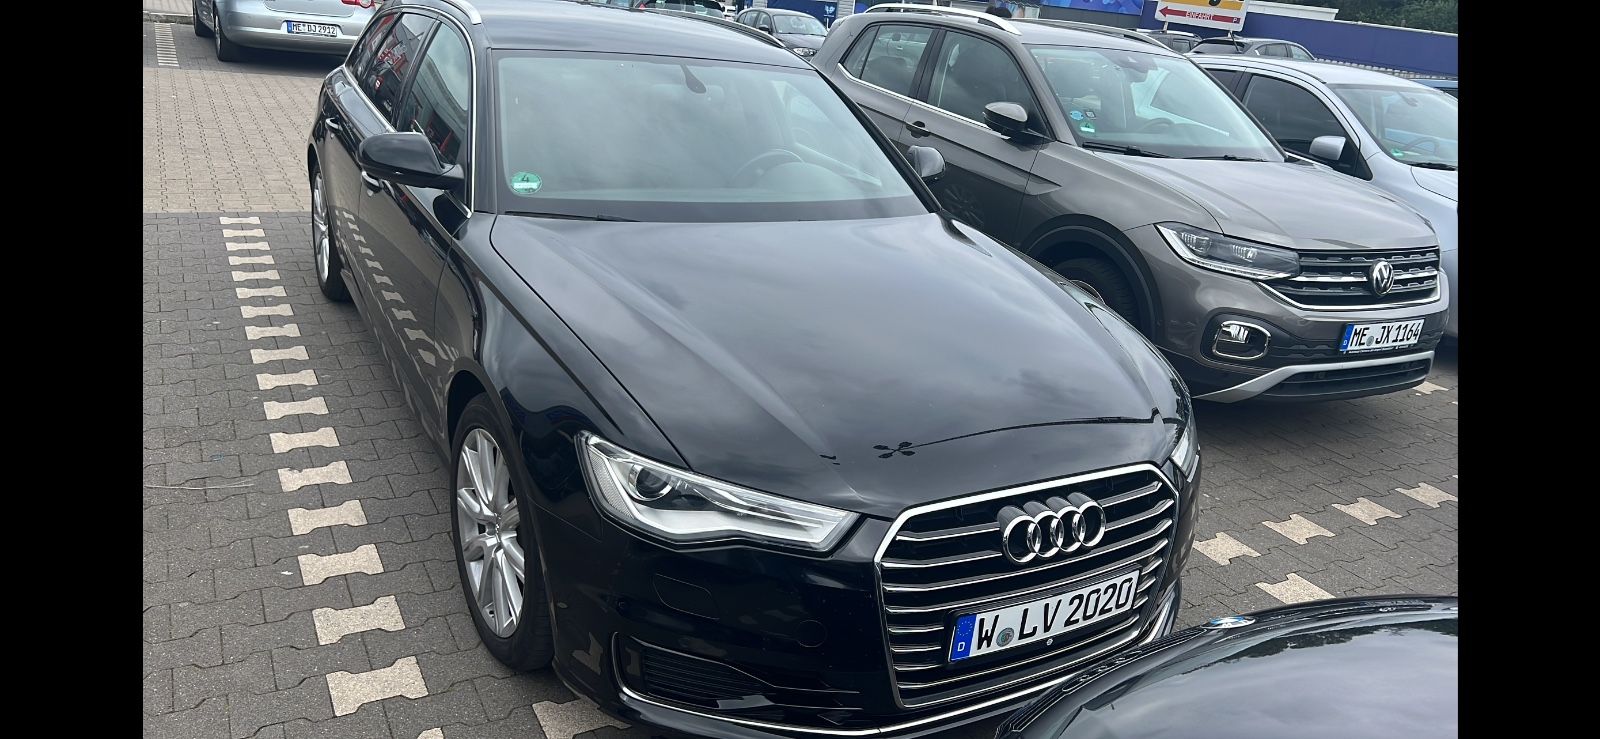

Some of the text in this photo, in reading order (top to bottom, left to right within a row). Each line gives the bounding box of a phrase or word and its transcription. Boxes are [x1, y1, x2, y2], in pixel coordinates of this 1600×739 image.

[1185, 10, 1213, 20] EINFAHRT
[292, 23, 302, 32] ME
[318, 25, 336, 35] 2912
[521, 174, 529, 183] 4
[1350, 327, 1369, 346] ME
[1375, 325, 1394, 344] JX
[1392, 322, 1421, 343] 1164
[957, 577, 1133, 652] D W LV 2020
